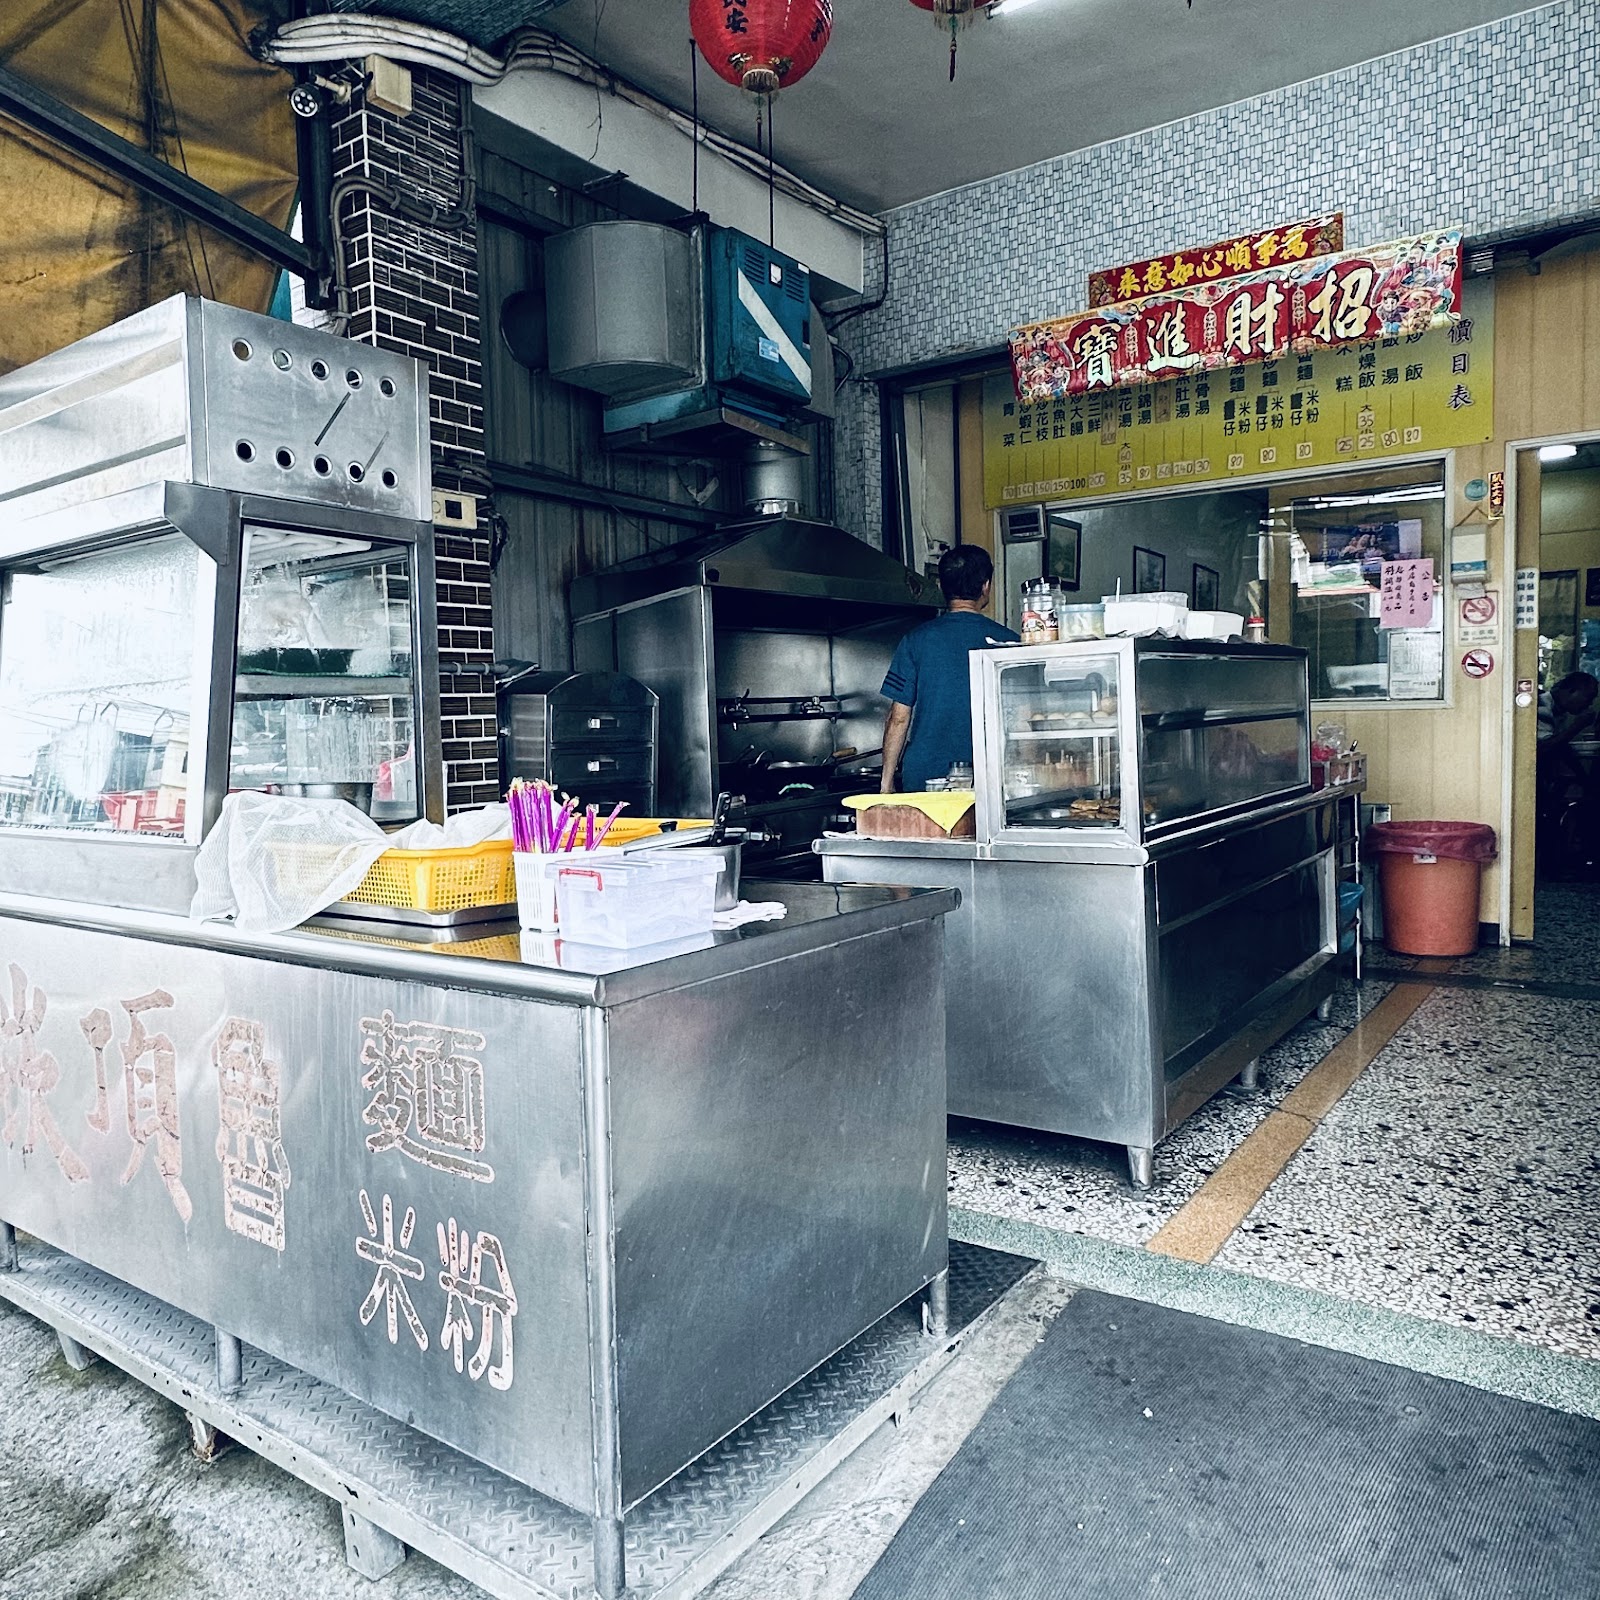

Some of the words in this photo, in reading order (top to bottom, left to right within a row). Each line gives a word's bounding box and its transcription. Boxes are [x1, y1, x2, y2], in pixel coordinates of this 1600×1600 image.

[1073, 266, 1375, 390] 招財進寶
[1448, 319, 1473, 410] 價目表
[1271, 396, 1284, 429] 米粉
[1306, 390, 1320, 423] 米粉
[1238, 401, 1251, 434] 米粉
[1360, 414, 1374, 427] 35
[1338, 439, 1352, 452] 25
[1360, 436, 1374, 447] 25
[1384, 431, 1397, 446] 80
[1262, 449, 1275, 461] 80
[1299, 444, 1311, 457] 80
[1052, 480, 1069, 492] 150
[1071, 478, 1086, 489] 100
[1421, 570, 1431, 602] 公告
[354, 1188, 519, 1392] 米粉
